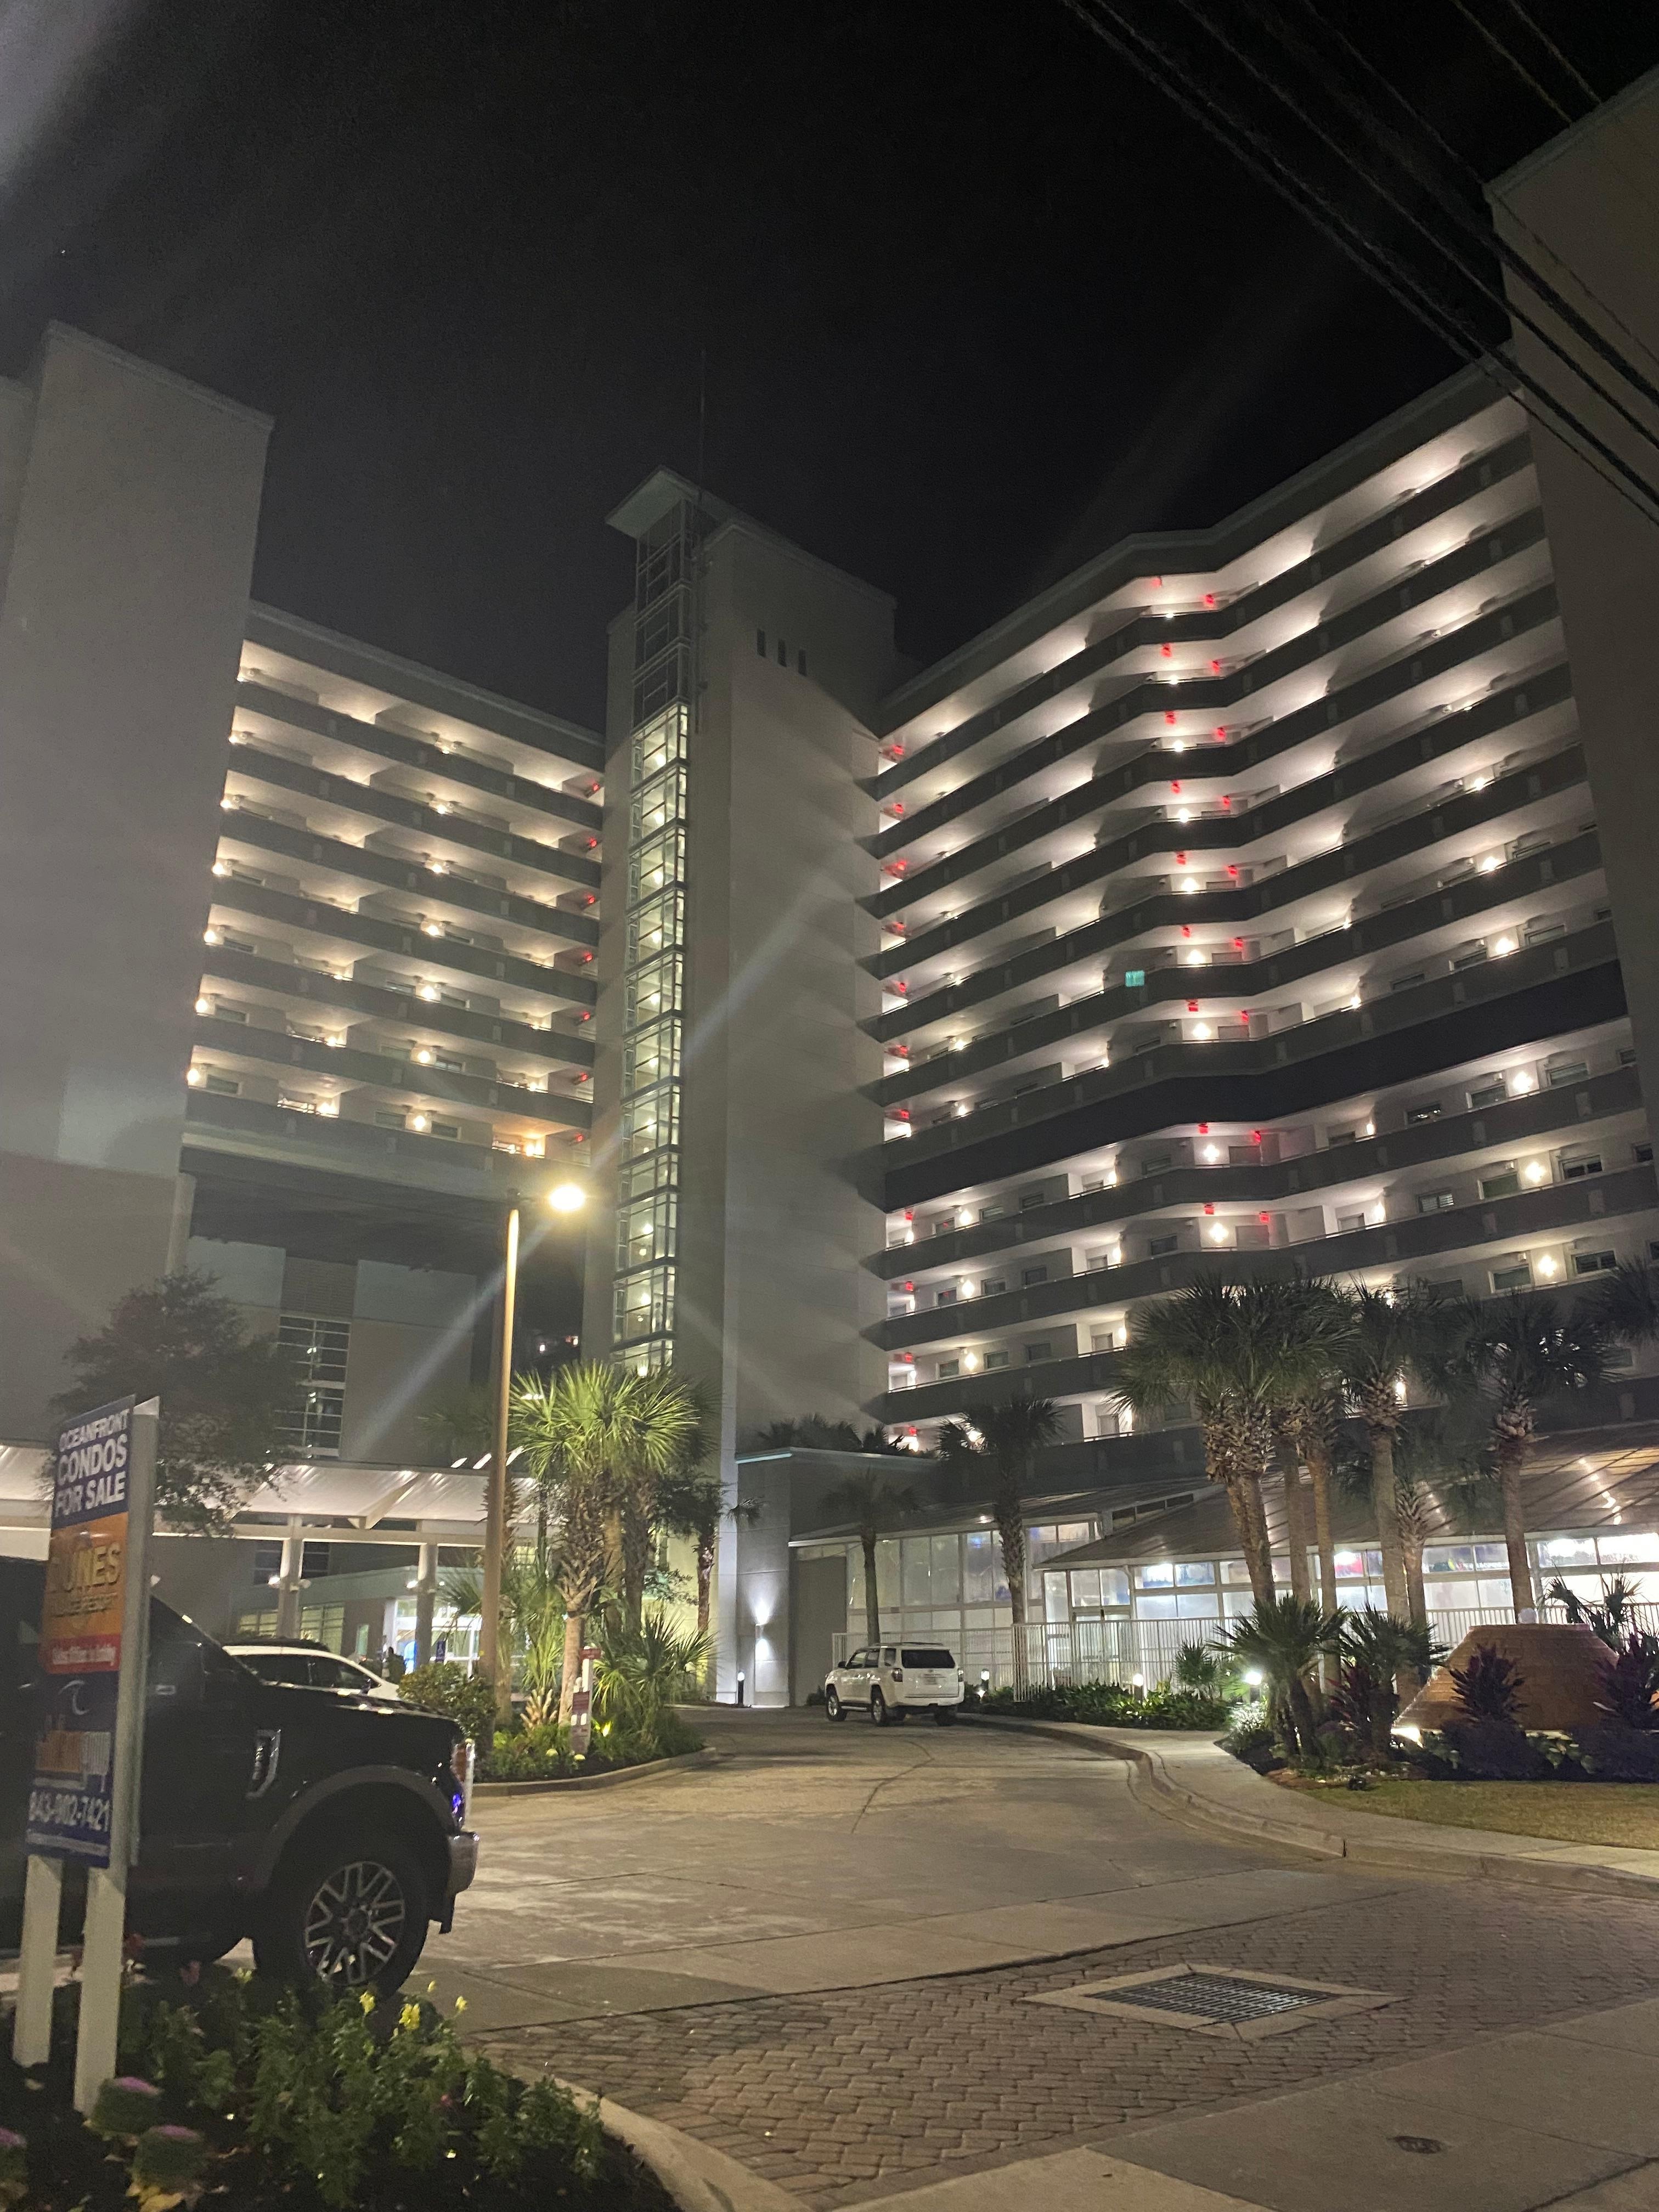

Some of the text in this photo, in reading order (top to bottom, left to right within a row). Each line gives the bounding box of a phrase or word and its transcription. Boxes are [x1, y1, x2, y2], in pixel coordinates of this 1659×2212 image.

[58, 1434, 127, 1486] CONDOS
[55, 1471, 126, 1517] FOR SALE
